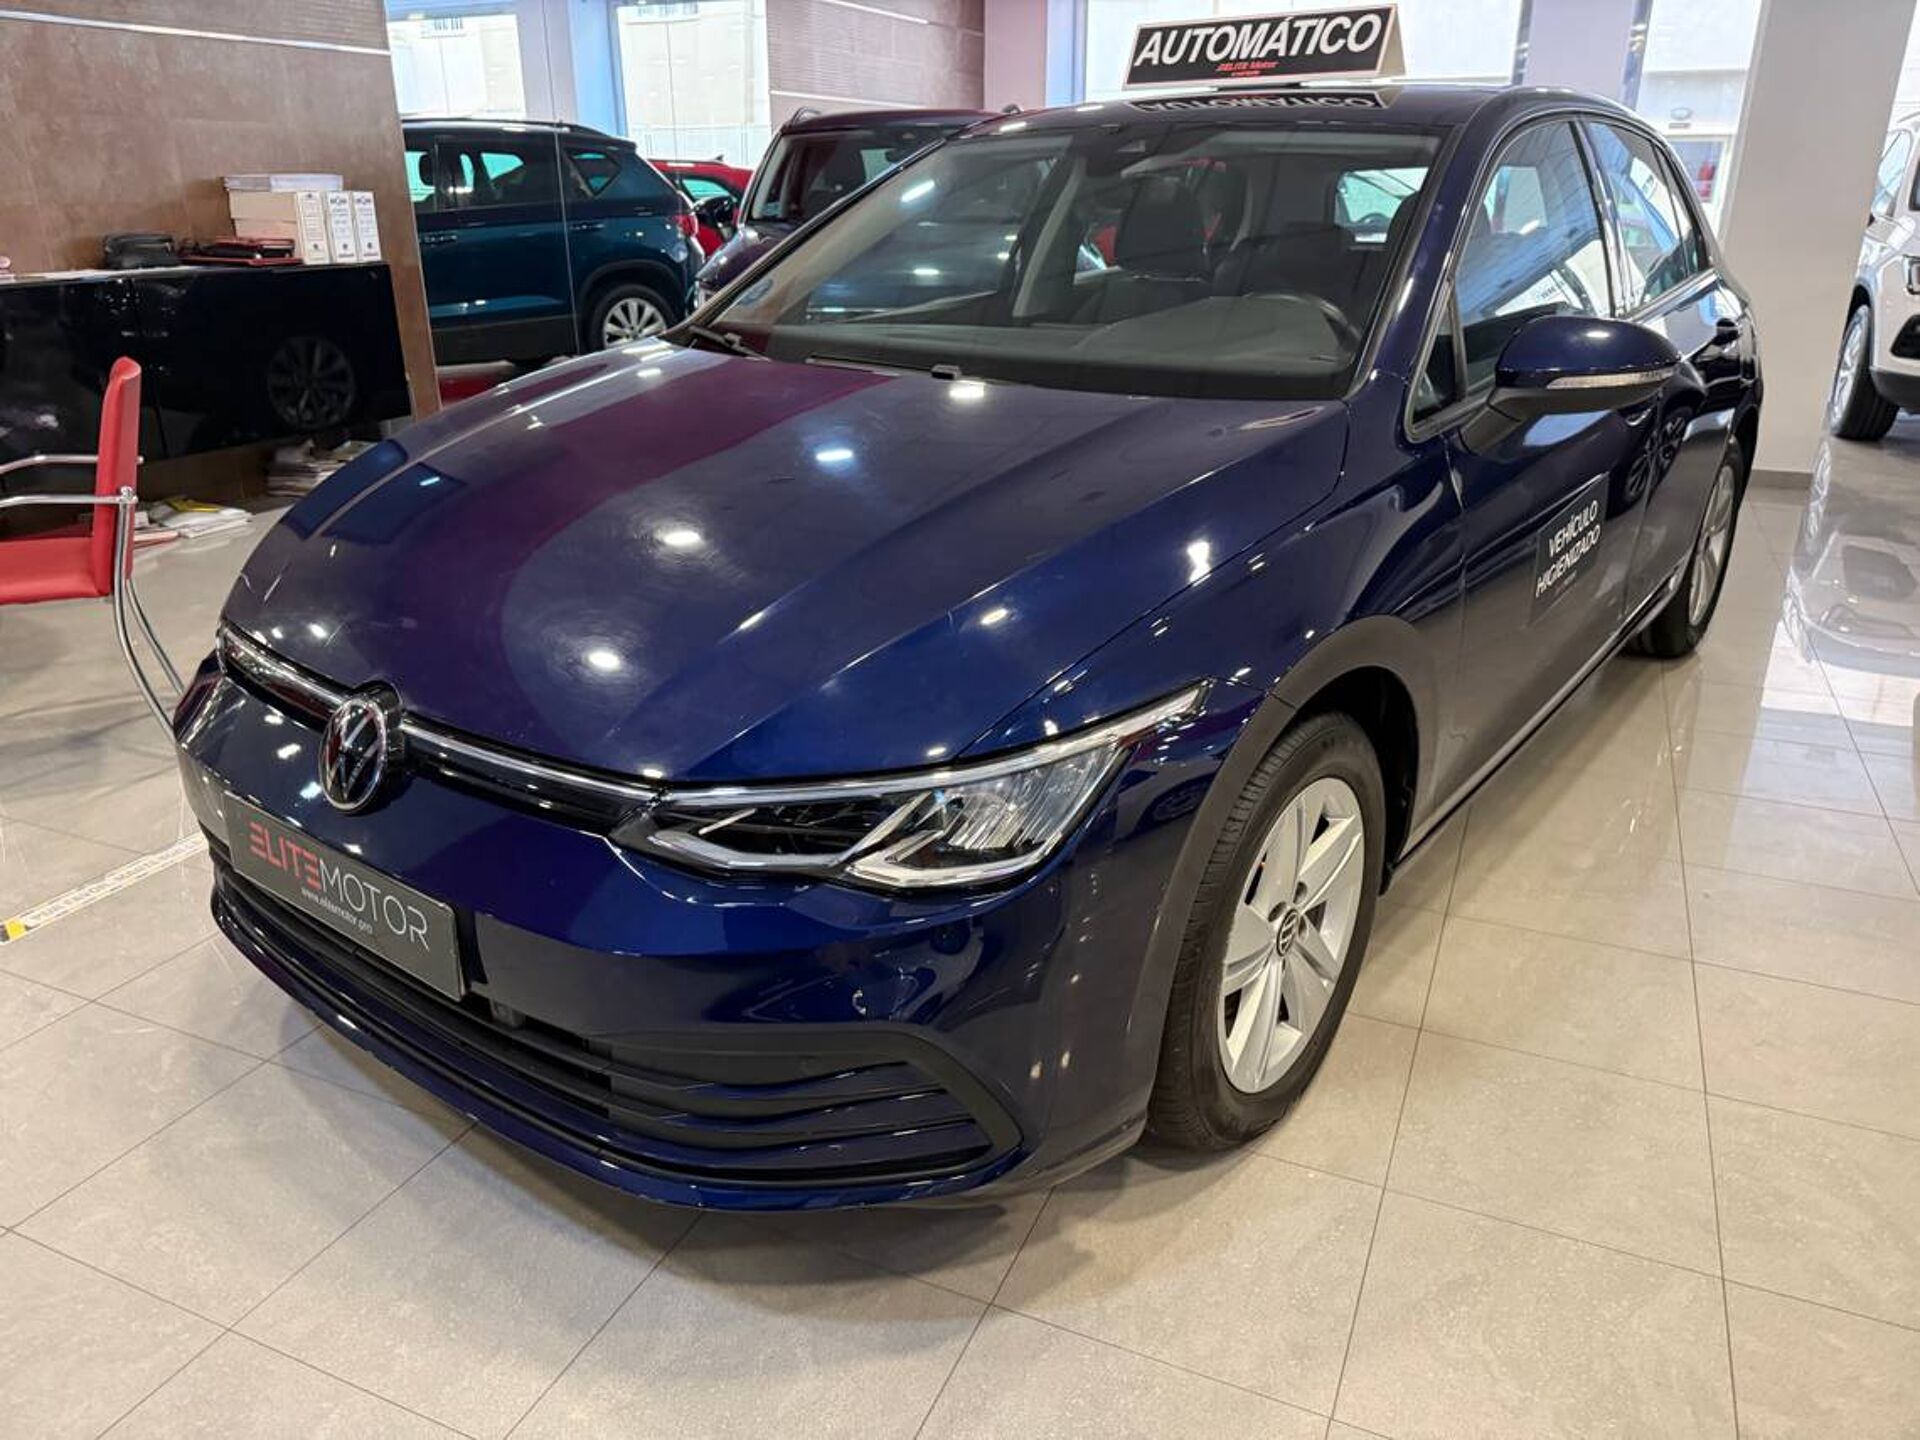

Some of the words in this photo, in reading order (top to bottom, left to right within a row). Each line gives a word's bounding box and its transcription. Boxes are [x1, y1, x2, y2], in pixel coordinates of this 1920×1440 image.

[1134, 14, 1382, 67] AUTOMÁTICO
[1549, 500, 1598, 557] VEHÍCULO
[1535, 525, 1601, 598] HIGIENIZADO
